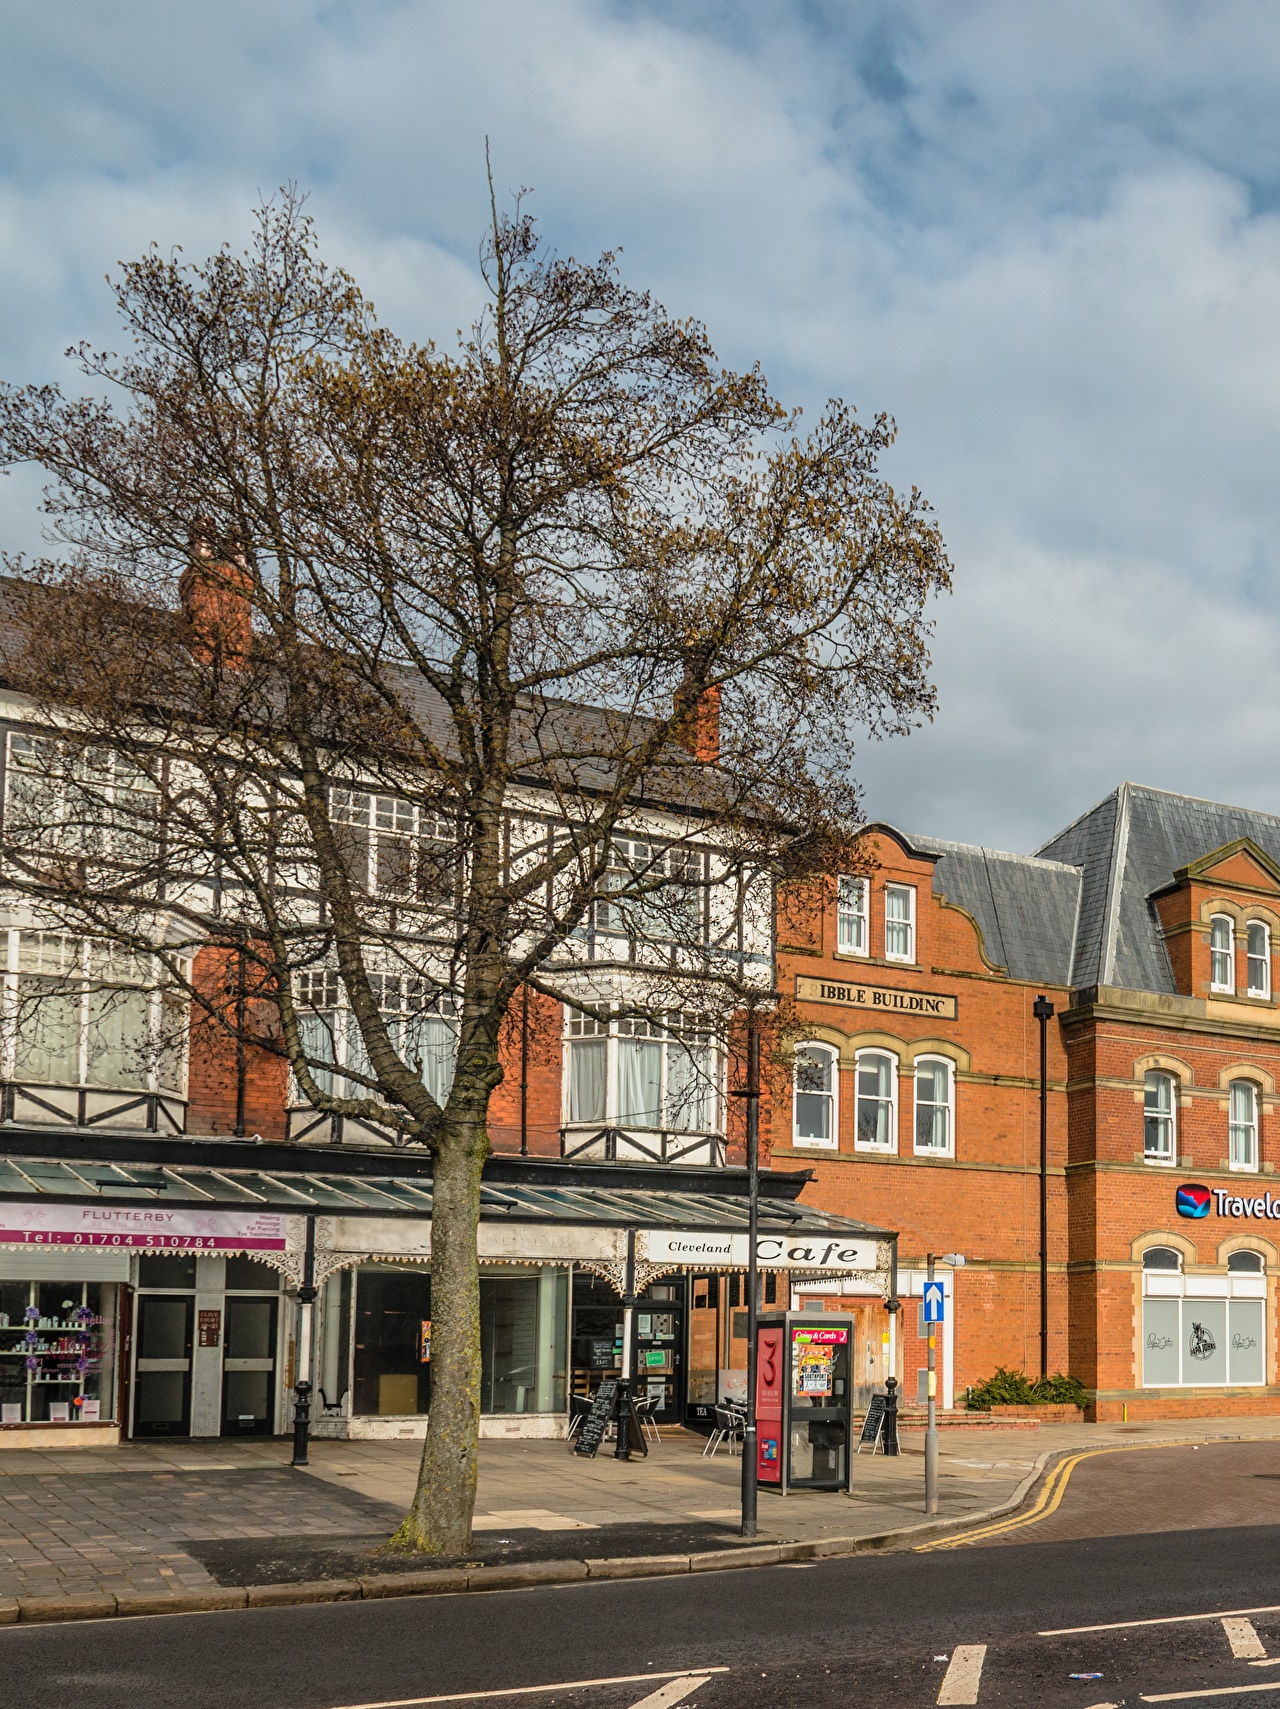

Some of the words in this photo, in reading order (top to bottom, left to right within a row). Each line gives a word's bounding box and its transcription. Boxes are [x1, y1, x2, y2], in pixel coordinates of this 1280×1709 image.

[82, 1210, 174, 1222] FLUTTERBY
[22, 1232, 61, 1243] Tel:
[74, 1234, 134, 1245] 01704
[146, 1236, 216, 1248] 510784
[668, 1241, 732, 1254] Cleveland
[756, 1240, 858, 1265] Cafe
[812, 1332, 819, 1340] &
[819, 1332, 836, 1340] Cards
[696, 1407, 708, 1416] TEA
